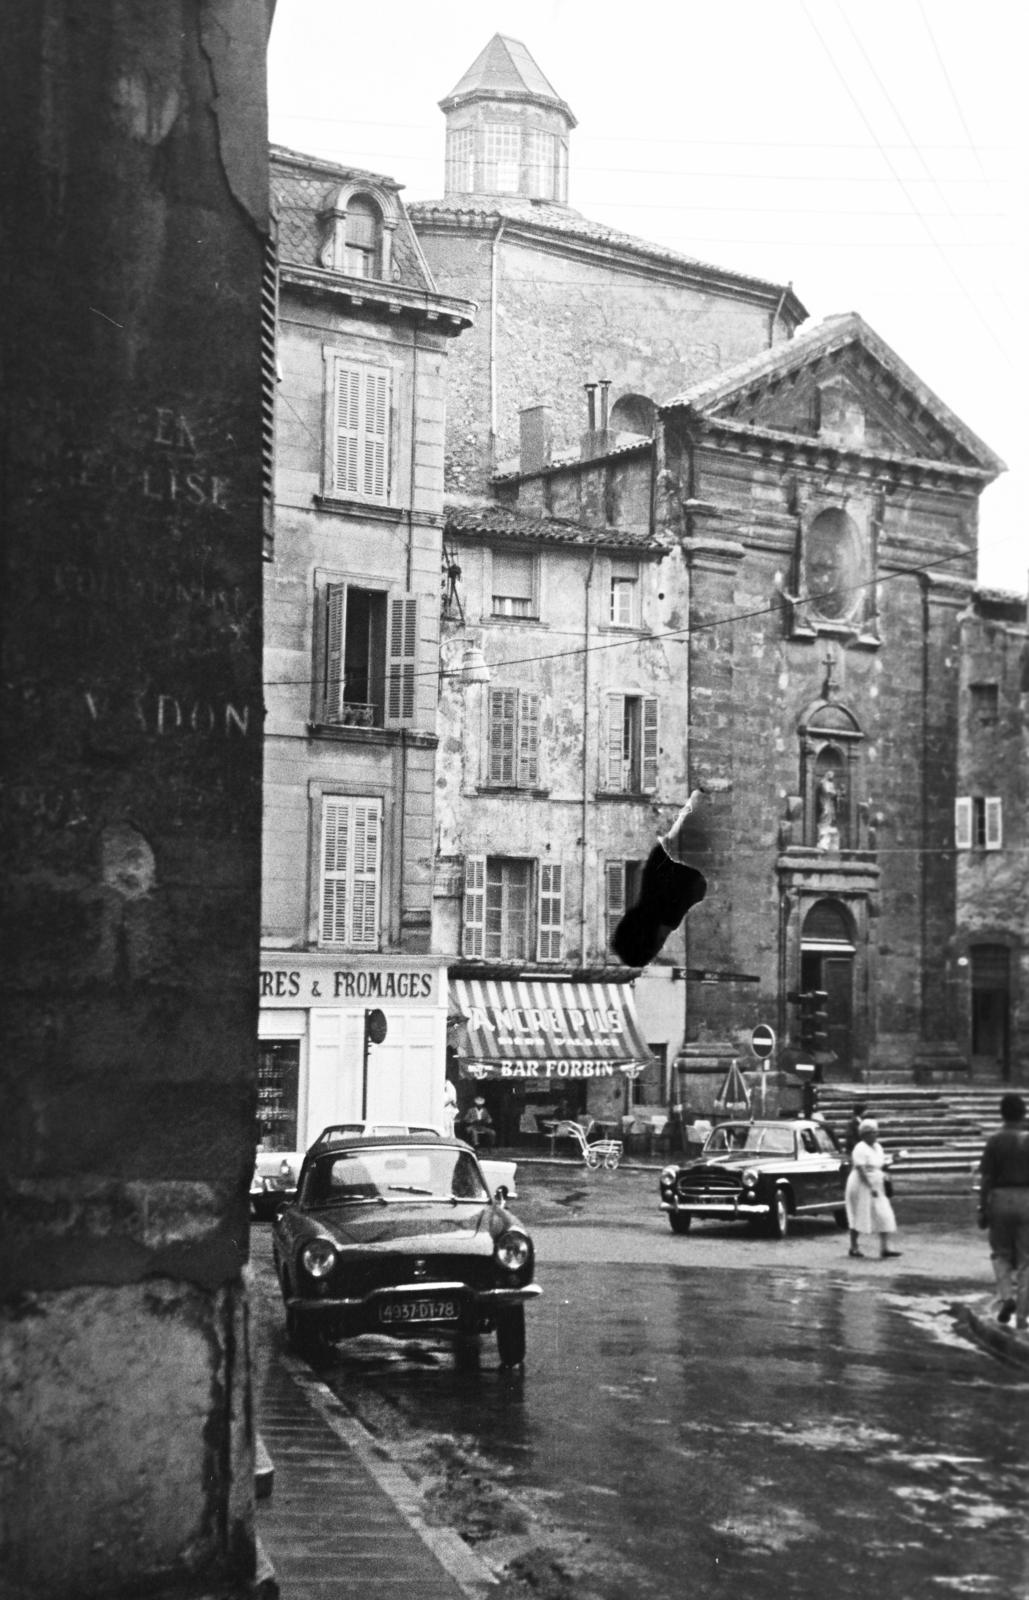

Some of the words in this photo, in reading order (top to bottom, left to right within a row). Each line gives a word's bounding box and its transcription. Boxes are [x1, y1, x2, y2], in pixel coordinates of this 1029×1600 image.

[311, 980, 322, 997] &
[333, 971, 432, 998] FROMAGES
[468, 1008, 562, 1033] ANCRE
[567, 1009, 623, 1033] PILS
[501, 1060, 540, 1077] BAR
[545, 1060, 614, 1077] FORBIN
